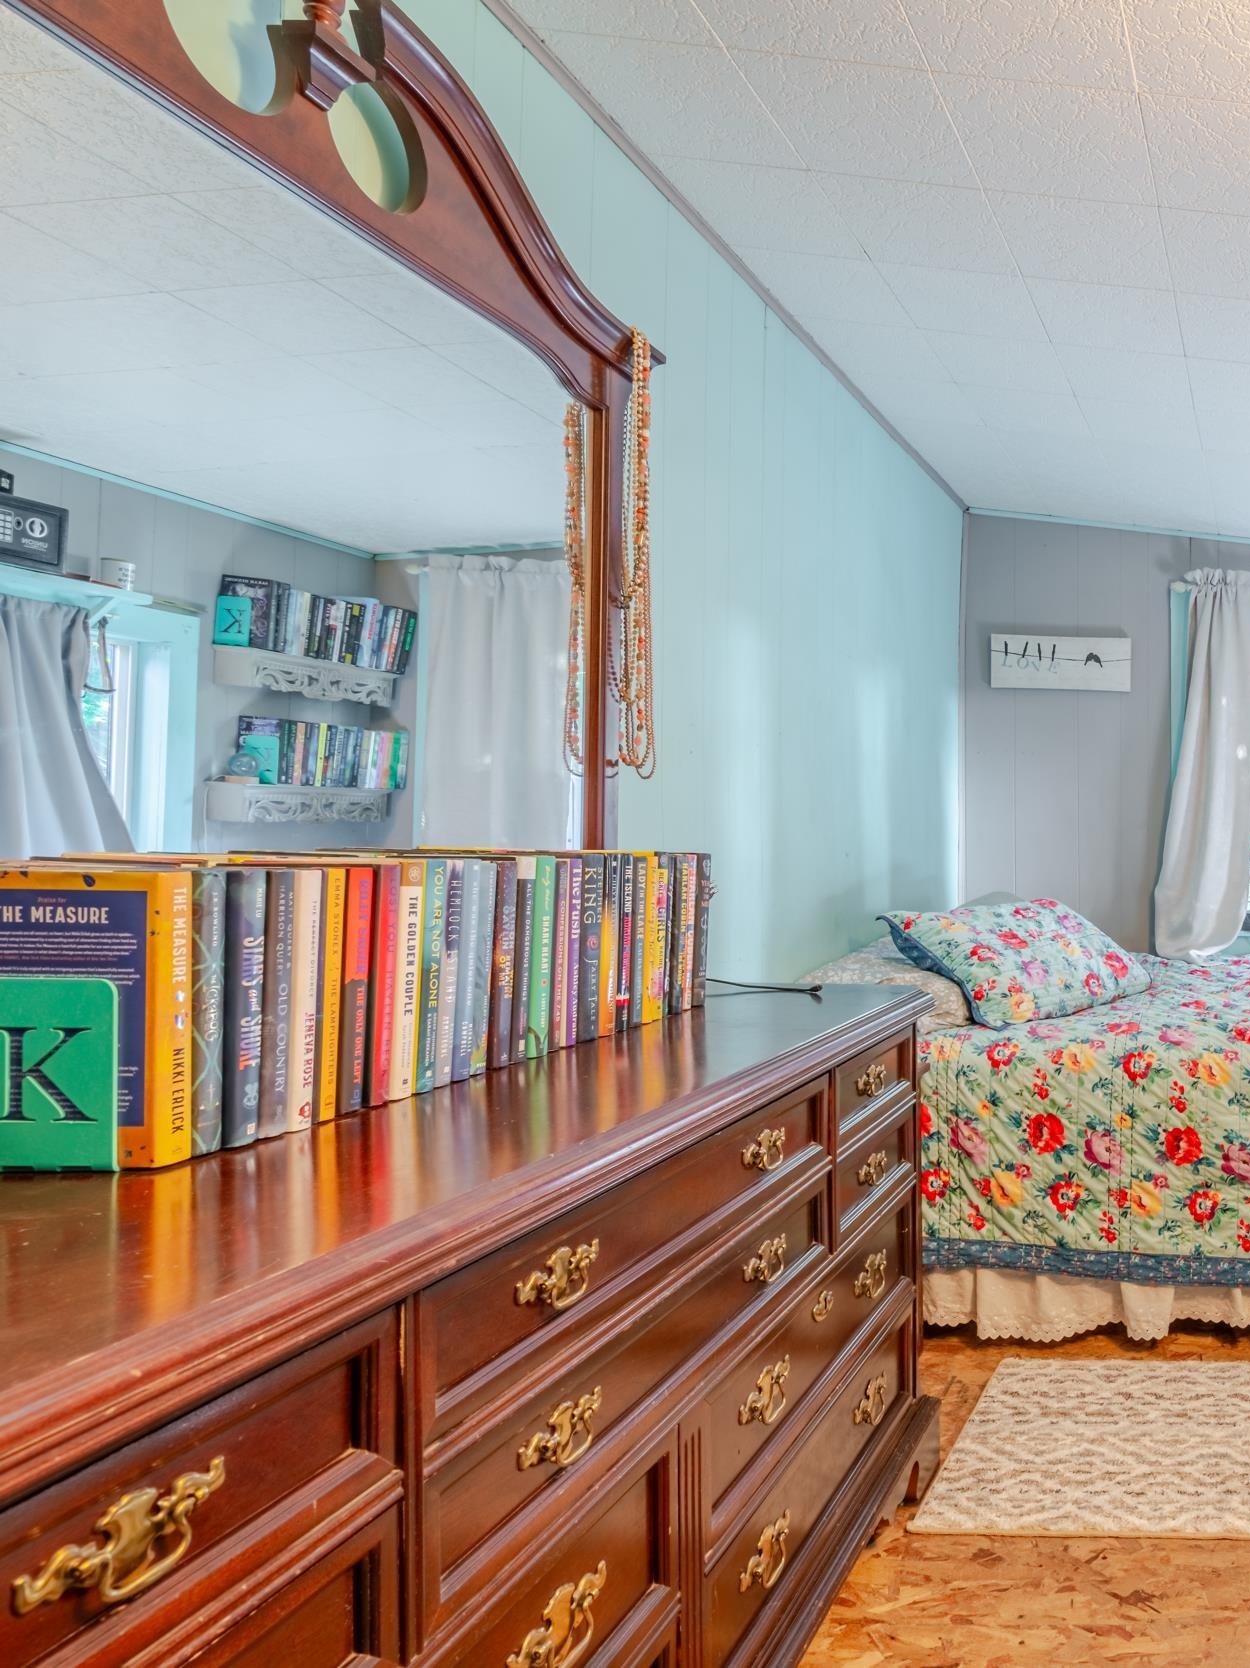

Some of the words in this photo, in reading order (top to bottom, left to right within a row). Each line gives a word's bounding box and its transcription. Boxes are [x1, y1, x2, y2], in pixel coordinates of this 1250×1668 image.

[433, 866, 445, 895] YOU
[572, 866, 583, 897] The
[624, 864, 634, 881] THE
[171, 887, 187, 913] THE
[255, 887, 265, 908] MARIE
[334, 877, 342, 909] EMMA
[408, 896, 418, 918] THE
[583, 866, 598, 925] KING
[624, 882, 633, 913] ISLAND
[31, 906, 110, 924] MEASURE
[255, 909, 263, 919] LU
[277, 884, 286, 939] HARRISON
[431, 898, 443, 926] ARE
[447, 880, 464, 943] HEMLOCK
[501, 905, 510, 950] GAYLIN
[571, 898, 581, 940] Push
[656, 906, 668, 944] GIRLS
[171, 917, 187, 984] MEASURE
[332, 913, 341, 956] STONEX
[406, 922, 417, 967] GOLDEN
[430, 929, 441, 959] NOT
[242, 935, 265, 987] STARS
[276, 942, 285, 977] QUERY
[446, 949, 459, 1004] ISLAND
[583, 958, 599, 992] FAIRY
[330, 978, 338, 998] THE
[355, 987, 365, 1007] THE
[403, 971, 415, 1017] COUPLE
[428, 961, 440, 1009] ALONE
[571, 962, 580, 997] Ashley
[246, 988, 261, 1011] and
[277, 983, 289, 1016] OLD
[588, 994, 599, 1022] TALE
[302, 1012, 316, 1056] JENEVA
[355, 1009, 364, 1033] ONLY
[571, 997, 579, 1039] Audrain
[239, 1014, 263, 1072] SMOKE
[274, 1023, 288, 1093] COUNTRY
[328, 1002, 337, 1085] LAMPLIGHTERS
[354, 1036, 363, 1057] ONE
[0, 1026, 96, 1122] K
[171, 1047, 185, 1084] NIKKI
[302, 1059, 314, 1089] ROSE
[353, 1060, 362, 1084] LEFT
[171, 1089, 186, 1135] ERLICK
